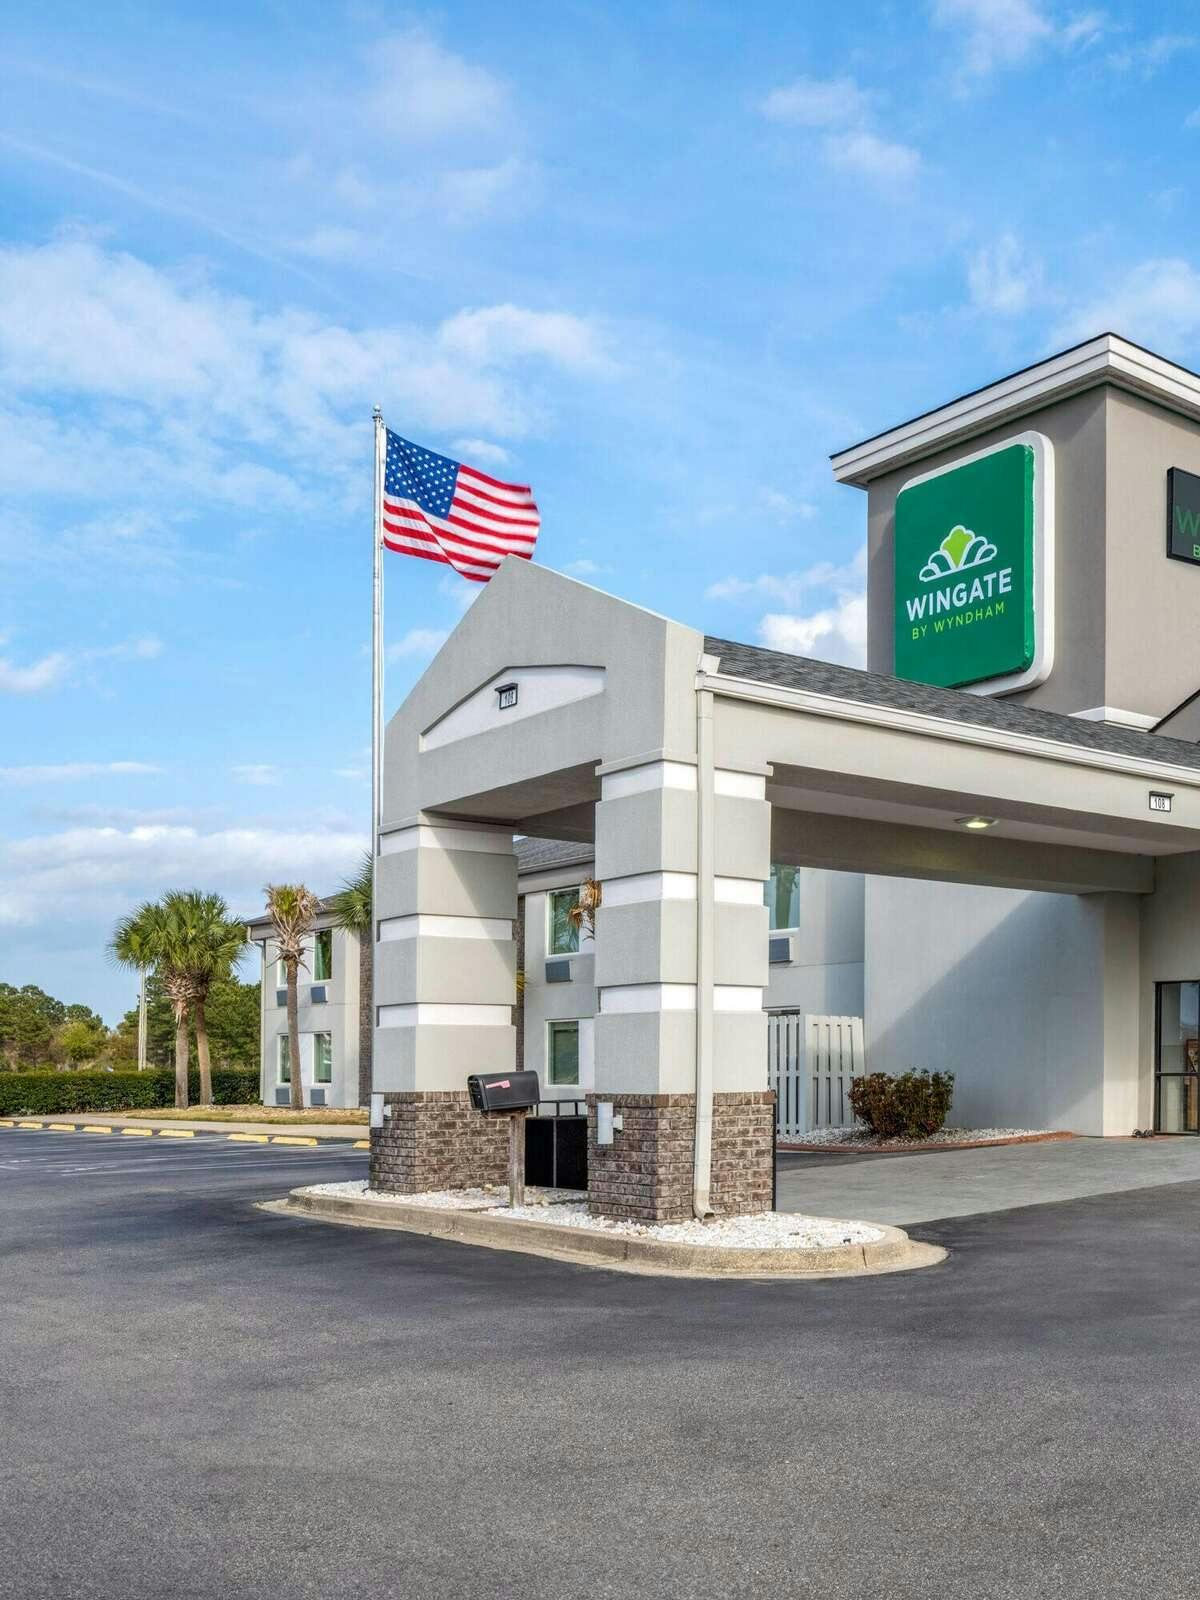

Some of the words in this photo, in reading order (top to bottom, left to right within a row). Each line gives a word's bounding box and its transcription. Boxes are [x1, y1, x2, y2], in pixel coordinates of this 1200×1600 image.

[906, 567, 1012, 622] WINGATE
[912, 624, 927, 640] BY
[934, 601, 1005, 633] WYNDHAM
